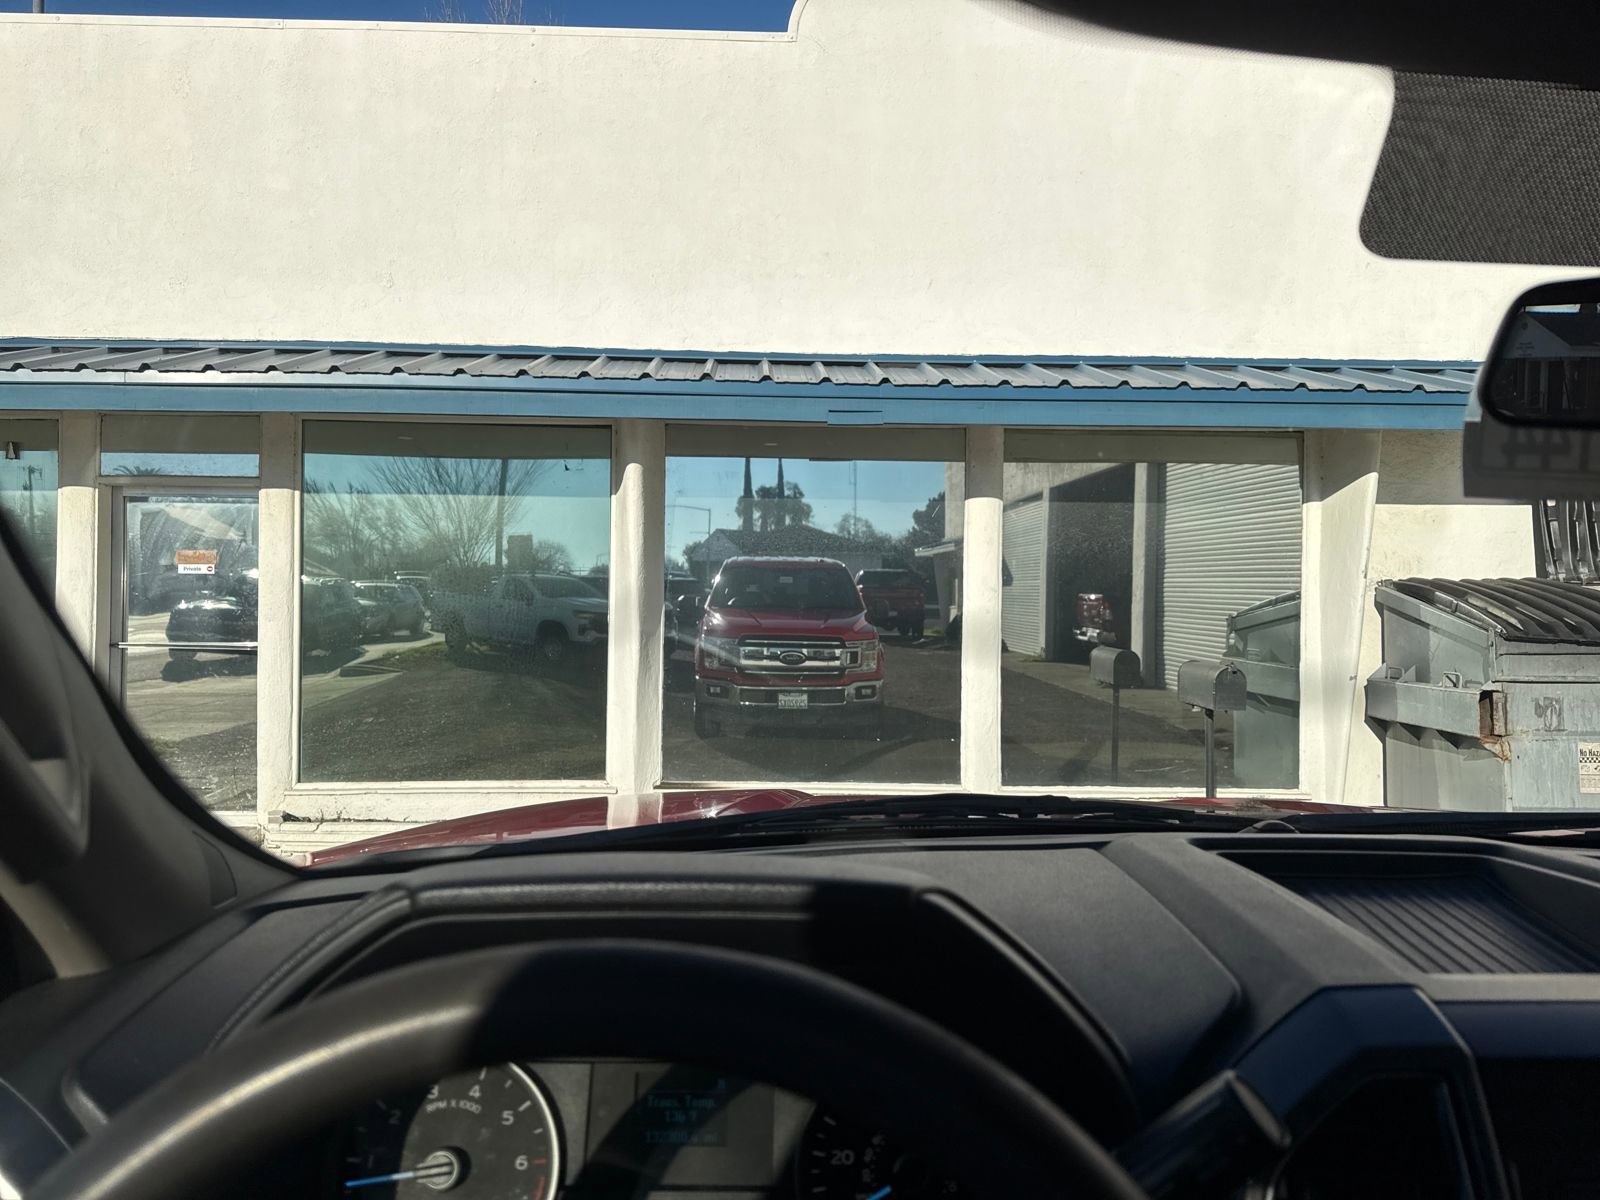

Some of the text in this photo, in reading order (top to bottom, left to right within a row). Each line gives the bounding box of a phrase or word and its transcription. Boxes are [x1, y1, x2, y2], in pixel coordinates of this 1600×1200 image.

[427, 1084, 439, 1099] 3
[469, 1084, 481, 1099] 4
[426, 1099, 447, 1113] RPM
[459, 1099, 482, 1114] 1000
[389, 1109, 400, 1125] 2
[501, 1110, 514, 1125] 5
[514, 1154, 528, 1171] 6
[830, 1149, 855, 1165] 20
